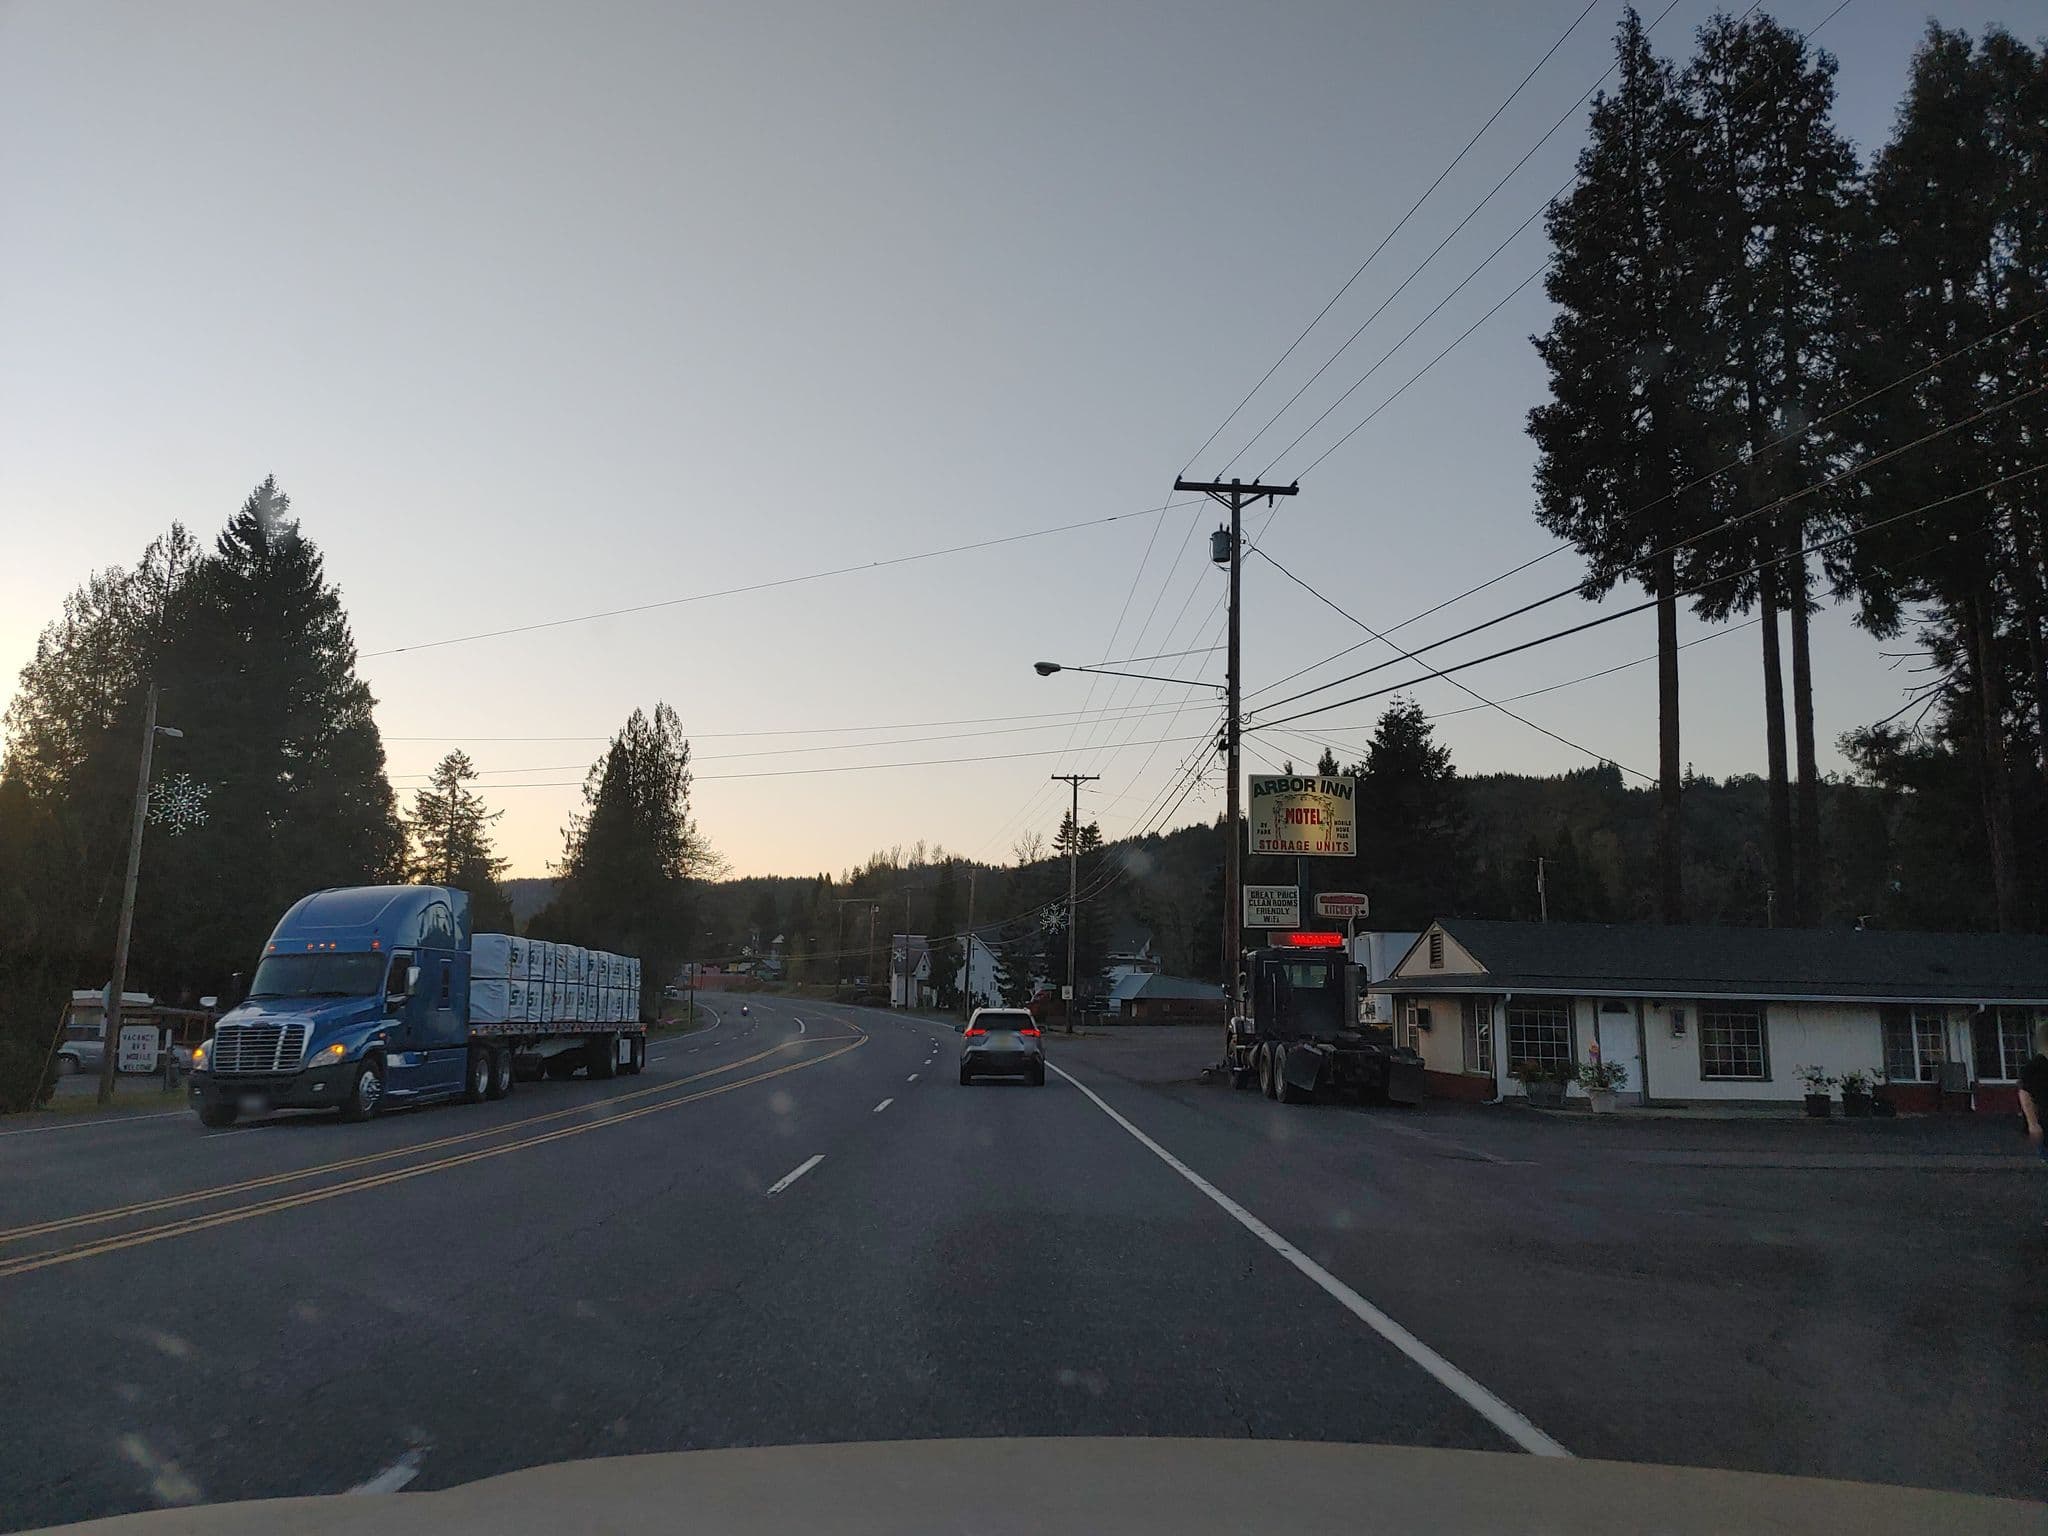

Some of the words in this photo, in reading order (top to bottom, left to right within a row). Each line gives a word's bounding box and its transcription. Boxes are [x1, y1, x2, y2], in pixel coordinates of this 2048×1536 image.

[1253, 778, 1316, 798] ARBOR
[1321, 780, 1353, 800] INN
[1285, 807, 1322, 825] MOTEL
[1259, 840, 1310, 851] STORAGE
[1316, 841, 1349, 852] UNITS
[1250, 891, 1274, 899] GREAT
[1277, 891, 1298, 899] PRICE
[1249, 899, 1271, 907] CLEAN
[1272, 899, 1298, 907] ROOMS
[1256, 907, 1290, 915] FRIENDLY
[1291, 934, 1342, 945] VACANCY
